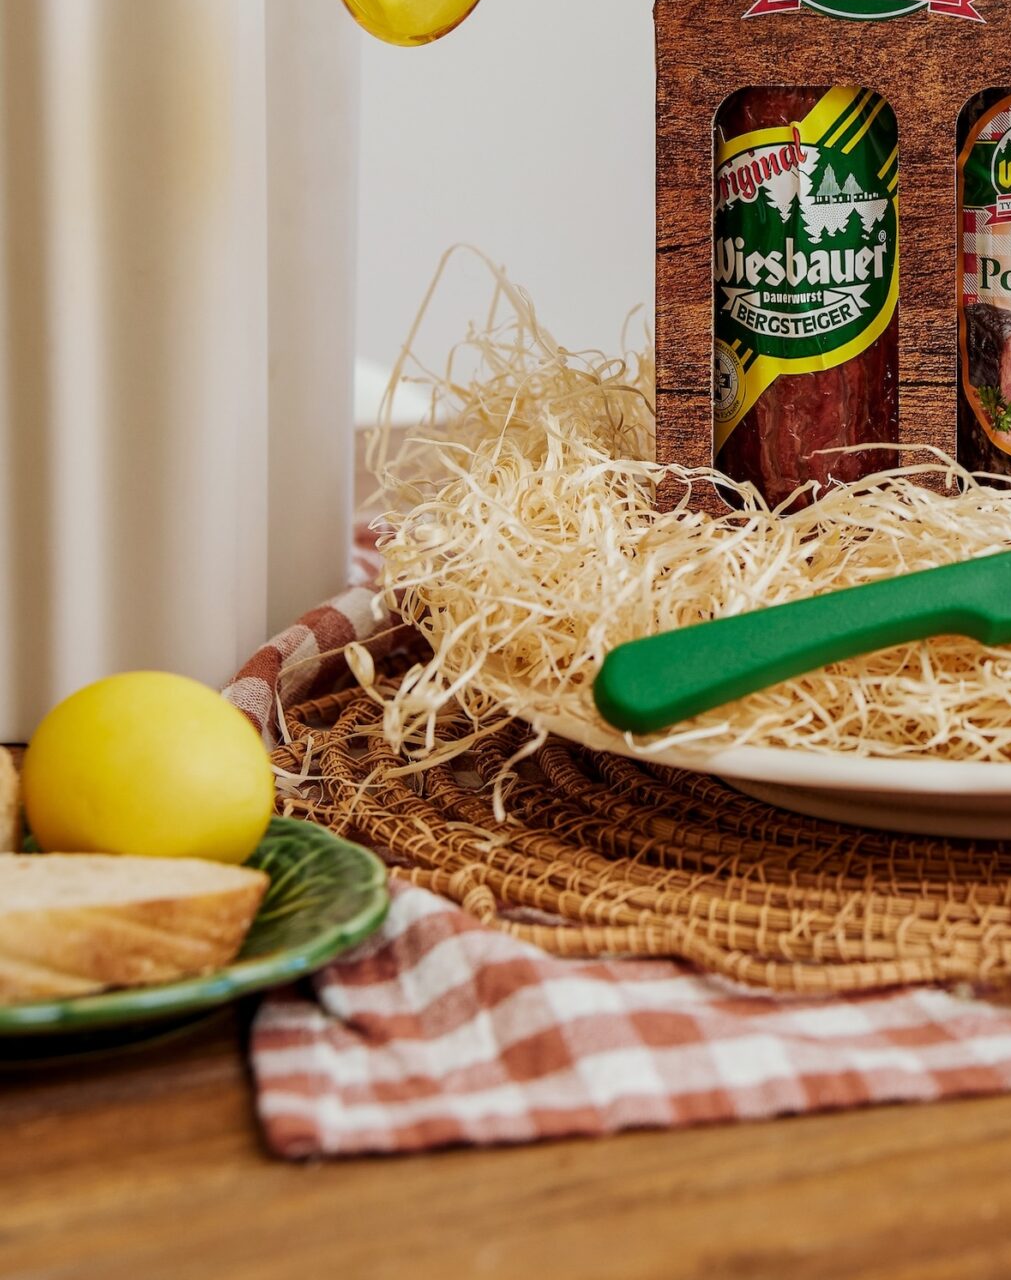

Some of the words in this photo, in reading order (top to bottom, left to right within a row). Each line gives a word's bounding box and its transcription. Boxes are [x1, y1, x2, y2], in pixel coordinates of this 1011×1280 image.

[715, 127, 807, 202] riginal
[714, 236, 887, 287] Wiesbauer
[763, 290, 823, 305] Dauerwurst
[736, 303, 854, 335] BERGSTEIGER
